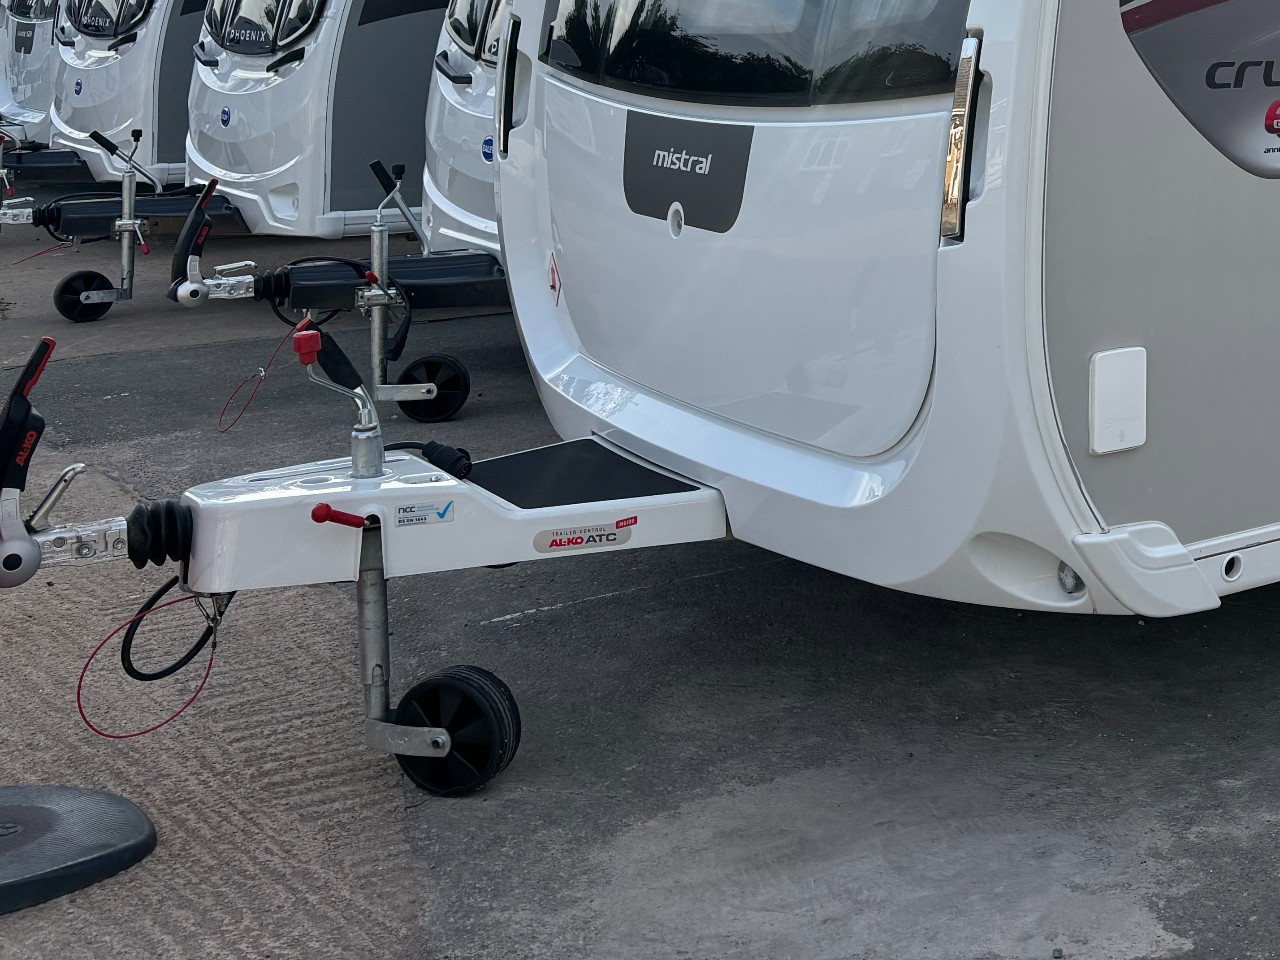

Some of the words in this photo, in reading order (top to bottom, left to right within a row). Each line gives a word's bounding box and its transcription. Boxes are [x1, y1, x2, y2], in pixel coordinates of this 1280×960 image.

[230, 30, 267, 42] PHOENIX
[653, 148, 712, 175] mistral
[617, 518, 636, 527] INSIDE
[552, 529, 577, 537] TRAILER
[548, 536, 584, 548] AL-KO
[585, 533, 617, 544] ATC
